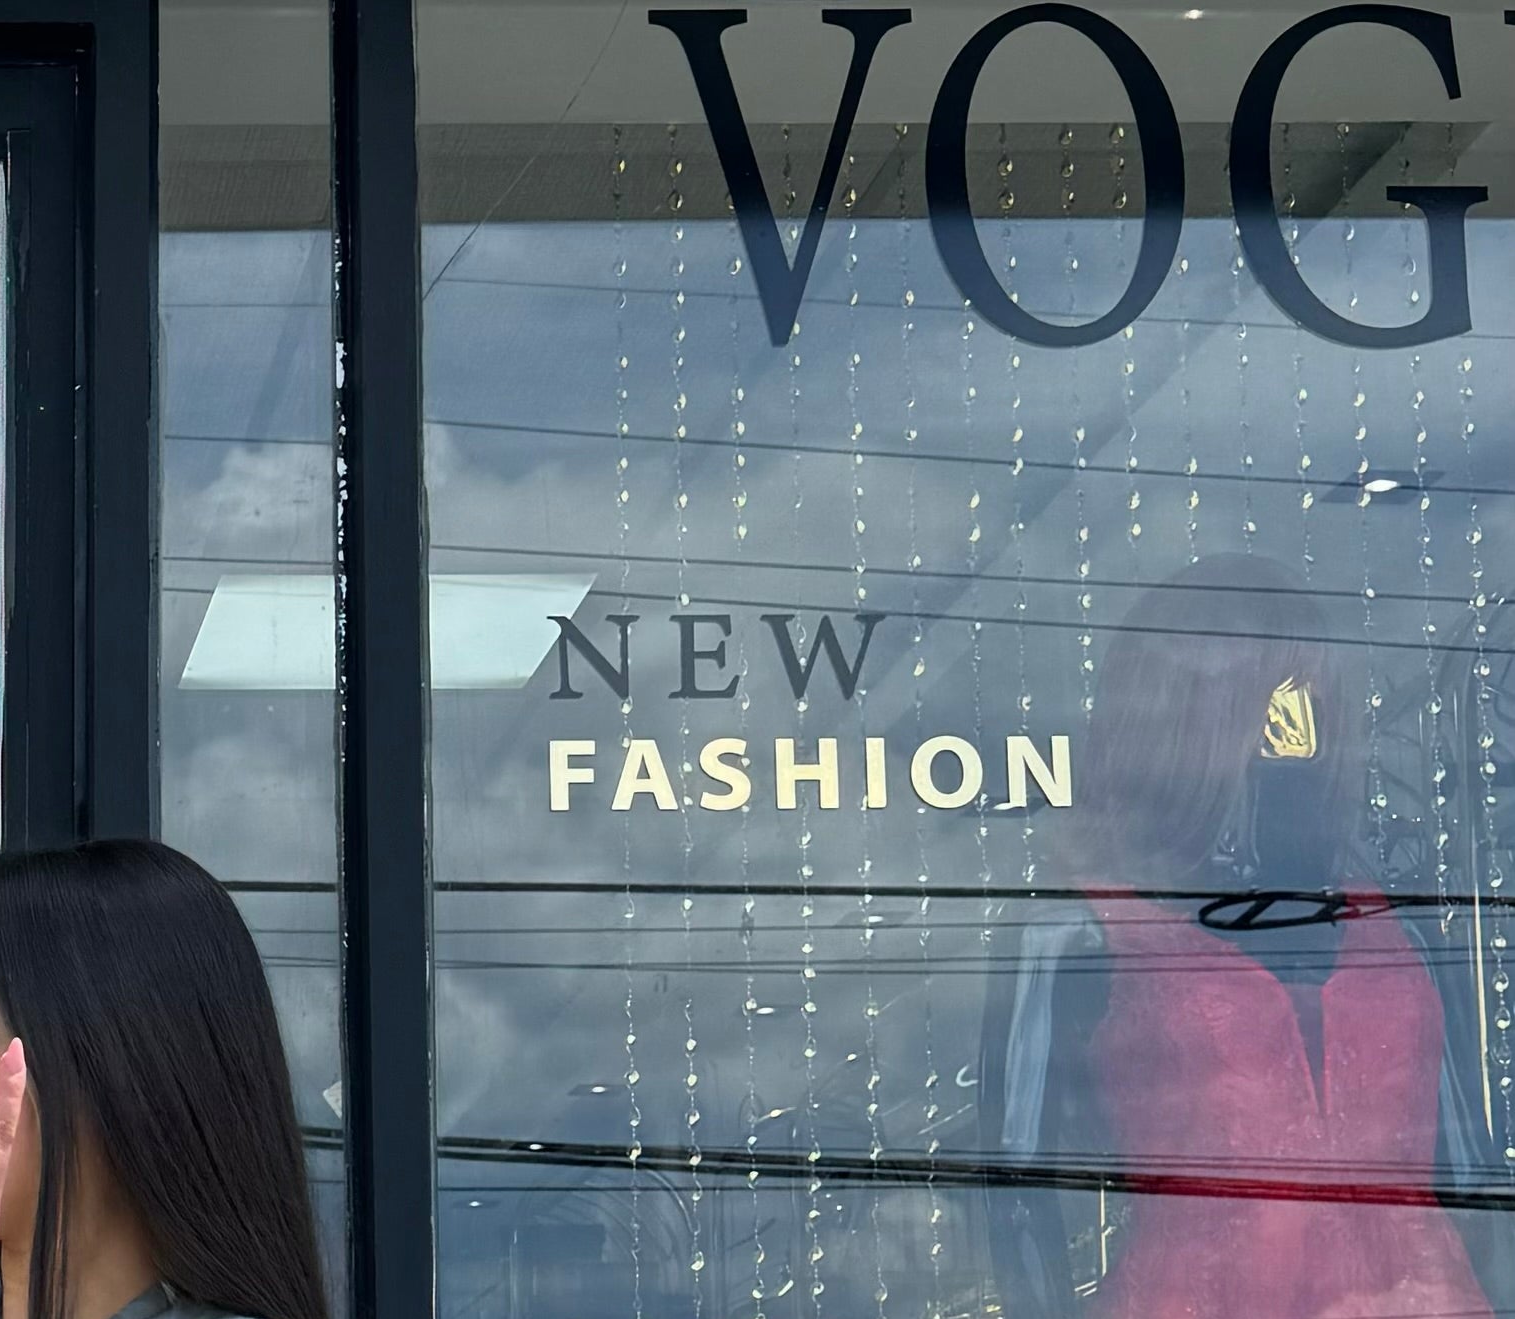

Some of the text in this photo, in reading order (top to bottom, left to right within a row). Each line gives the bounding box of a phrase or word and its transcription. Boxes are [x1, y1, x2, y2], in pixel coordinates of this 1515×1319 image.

[648, 2, 1515, 350] VOG
[547, 614, 885, 700] NEW
[549, 735, 1074, 811] FASHION
